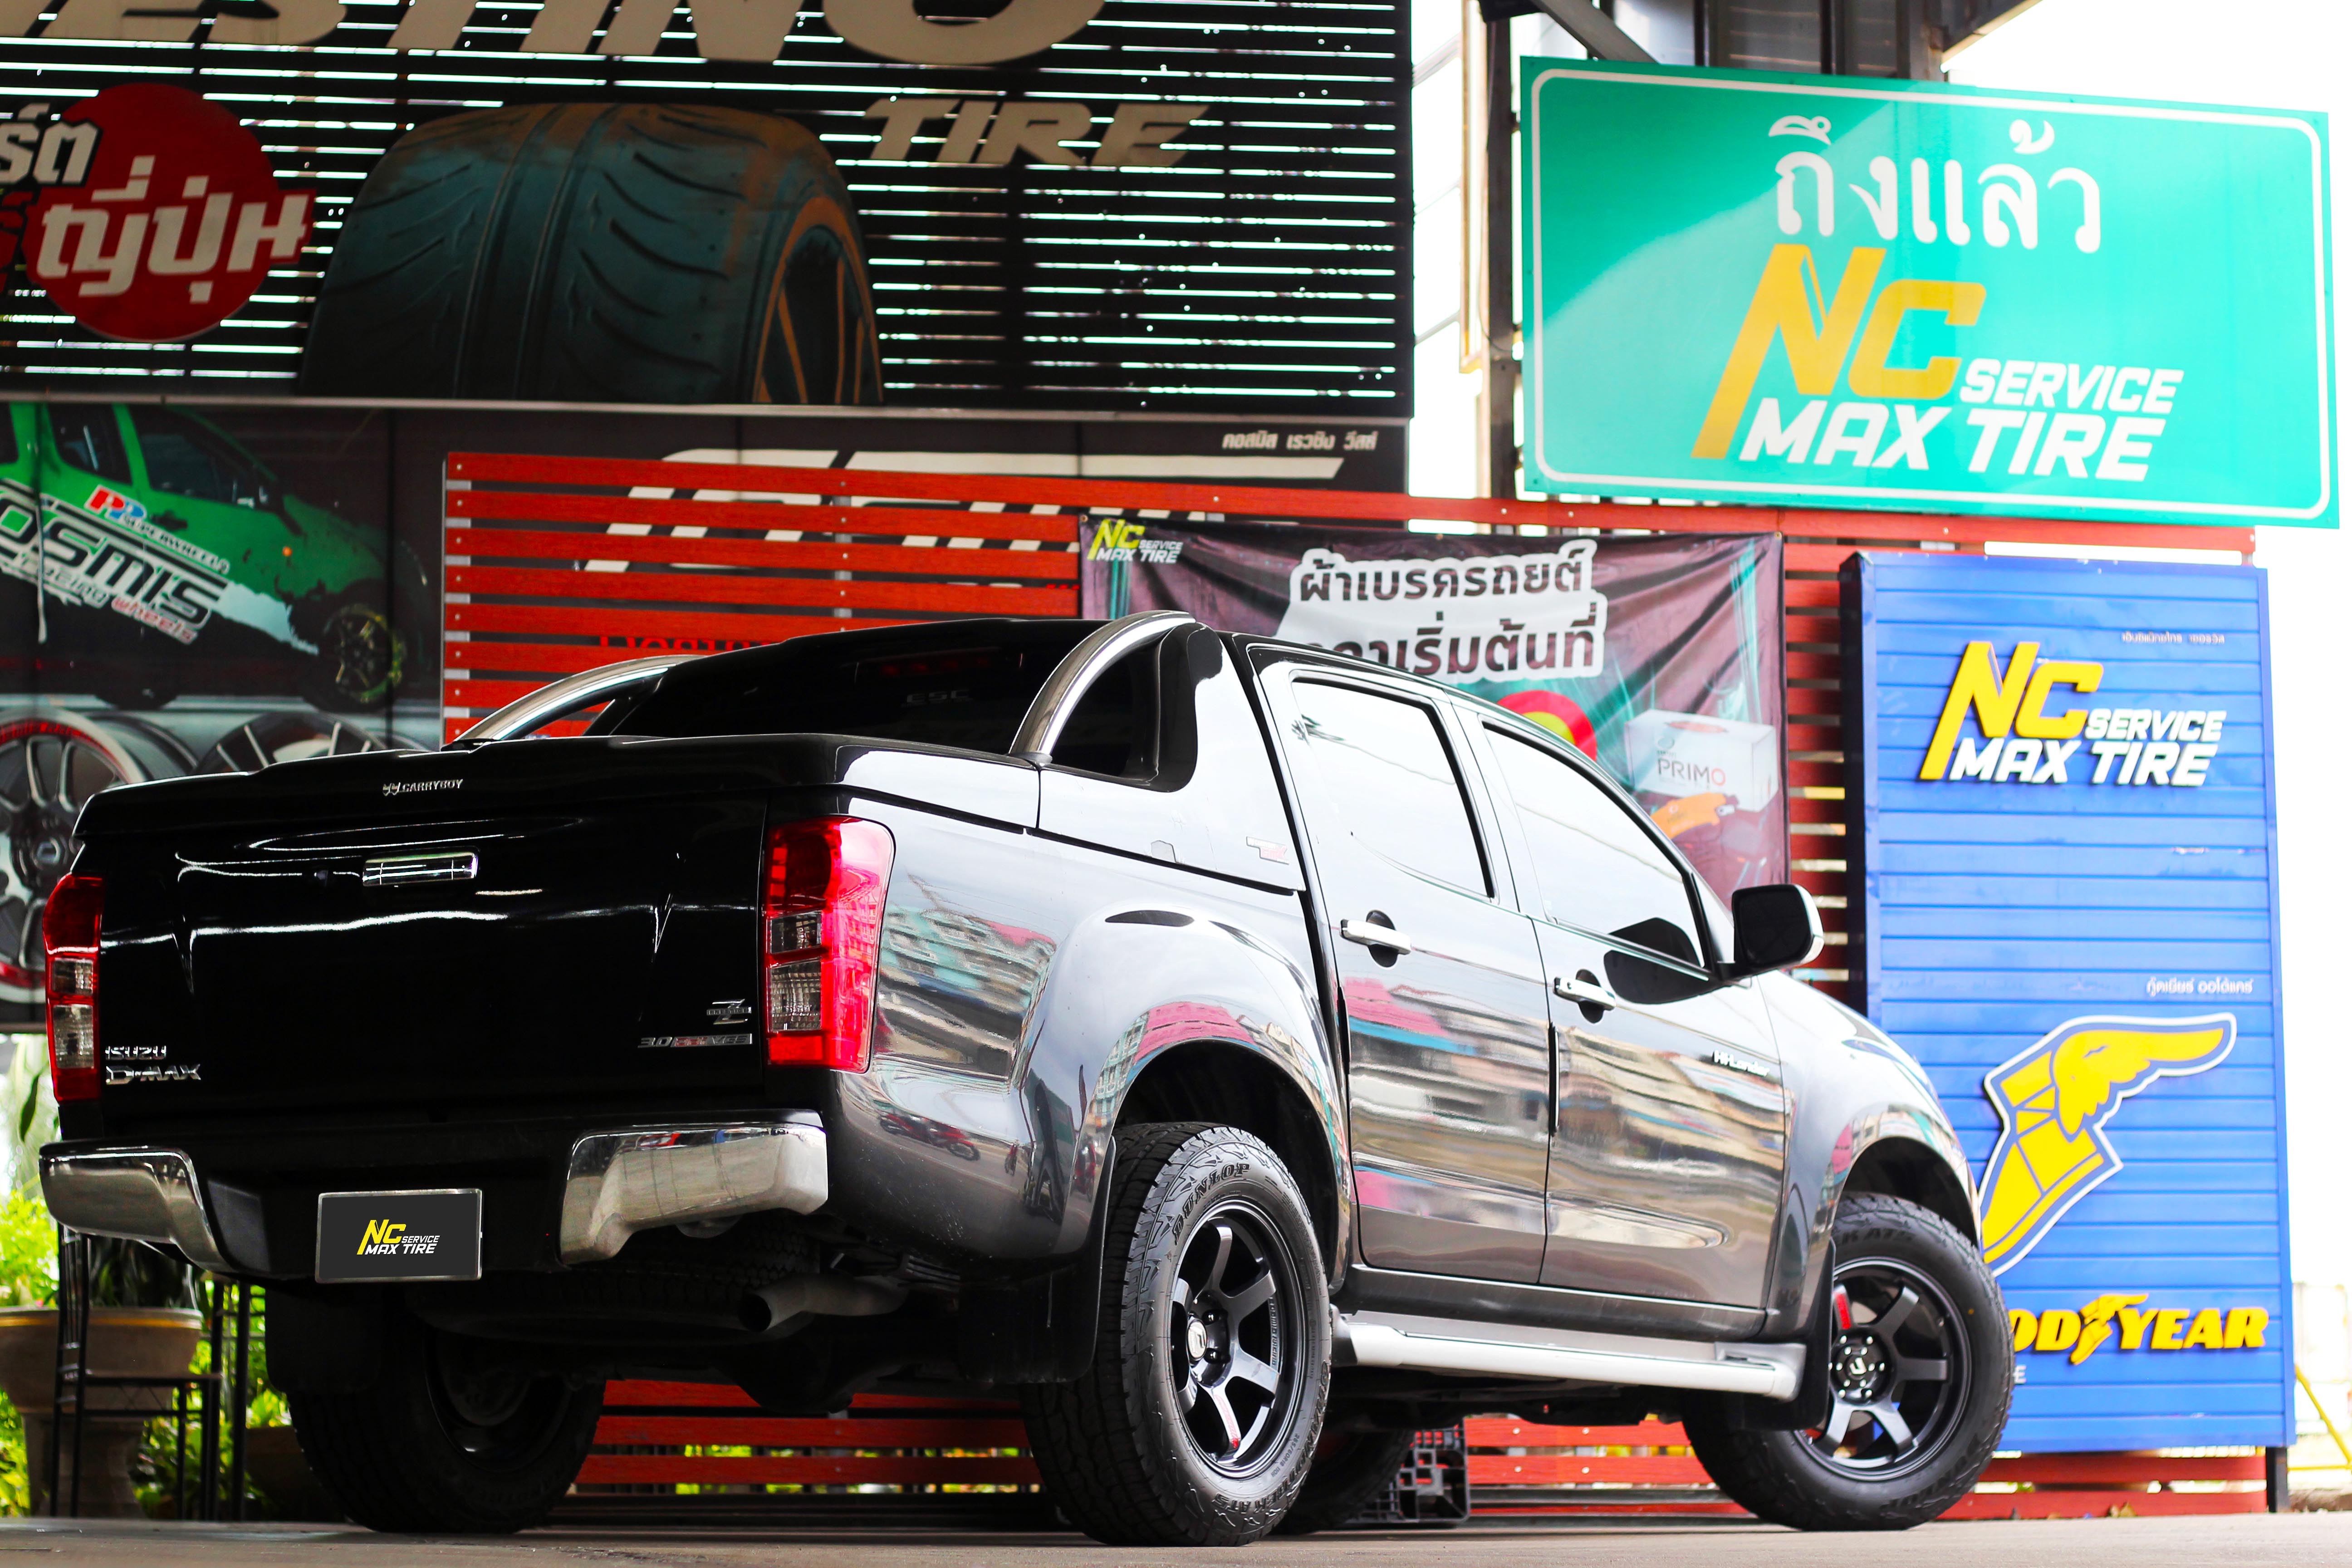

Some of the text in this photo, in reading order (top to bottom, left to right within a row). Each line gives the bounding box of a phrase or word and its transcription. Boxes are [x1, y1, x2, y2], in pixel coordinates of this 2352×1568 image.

[863, 98, 1209, 168] TIRE
[1769, 115, 2101, 254] ถึงแล้ว
[36, 155, 310, 304] ญี่ปุ่น
[1690, 243, 2184, 459] NC SERVICE
[1739, 397, 2166, 481] MAX TIRE
[1088, 519, 1183, 560] NC SERVICE
[1096, 548, 1180, 564] MAX TIRE
[1920, 641, 2227, 779] NC SERVICE
[402, 779, 463, 792] CARRYBOY
[1657, 758, 1726, 788] PRIMO
[1949, 737, 2218, 787] MAX TIRE
[105, 1045, 167, 1060] ISUZU
[1173, 1162, 1250, 1246] DUNLOP
[357, 1219, 440, 1255] NC SERVICE
[365, 1243, 437, 1255] MAX TIRE
